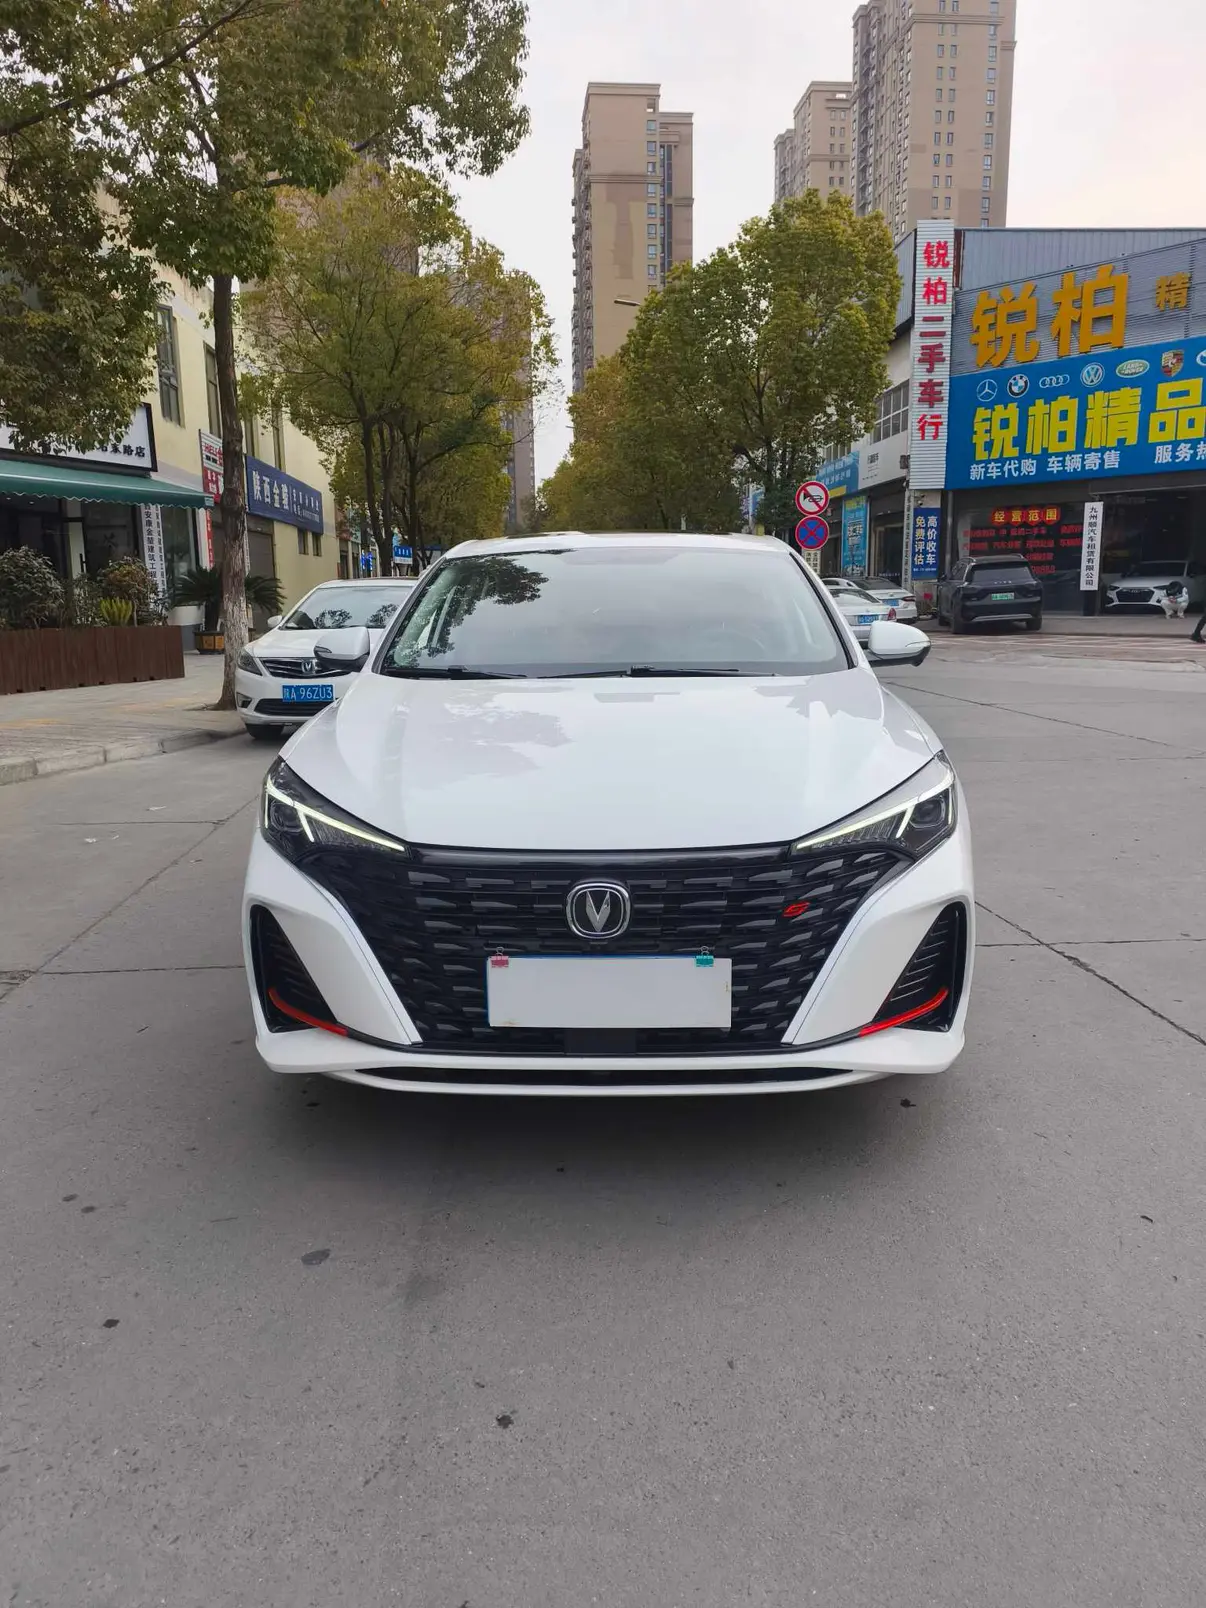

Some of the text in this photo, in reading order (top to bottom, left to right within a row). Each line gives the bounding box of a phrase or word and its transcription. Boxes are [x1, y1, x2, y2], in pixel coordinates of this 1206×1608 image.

[917, 240, 950, 440] 锐柏二手车行
[970, 264, 1191, 368] 锐柏 精
[972, 377, 1206, 461] 锐柏精品
[970, 458, 1037, 481] 新车代购
[1047, 450, 1121, 474] 车辆寄售
[914, 515, 926, 565] 免费评估
[925, 515, 938, 565] 高价收车
[992, 507, 1057, 523] 经营范围
